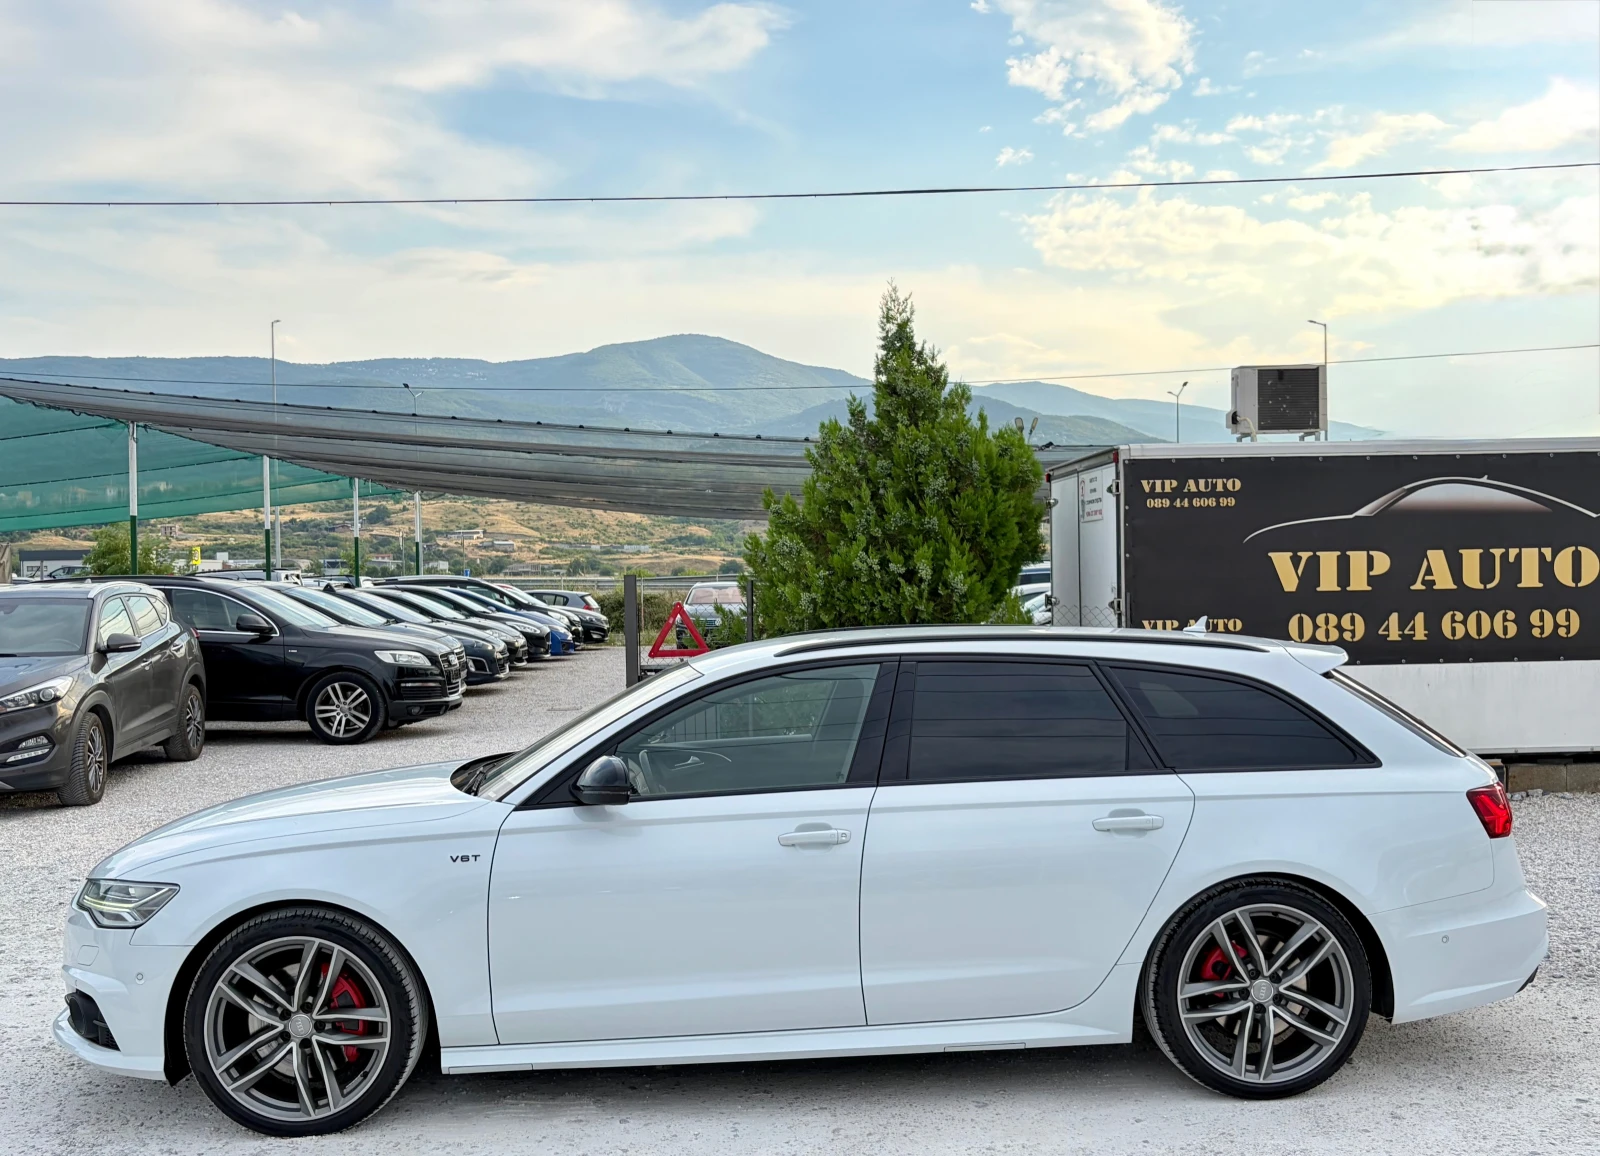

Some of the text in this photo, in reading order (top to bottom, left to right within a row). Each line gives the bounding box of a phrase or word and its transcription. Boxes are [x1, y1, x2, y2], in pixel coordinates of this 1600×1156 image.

[1141, 478, 1242, 493] VIP AUTO
[1146, 497, 1236, 508] 089 44 606 99
[1267, 545, 1600, 592] VIP AUTO
[1142, 619, 1179, 631] VIP
[1288, 608, 1580, 642] 089 44 606 99
[449, 854, 481, 863] V6T
